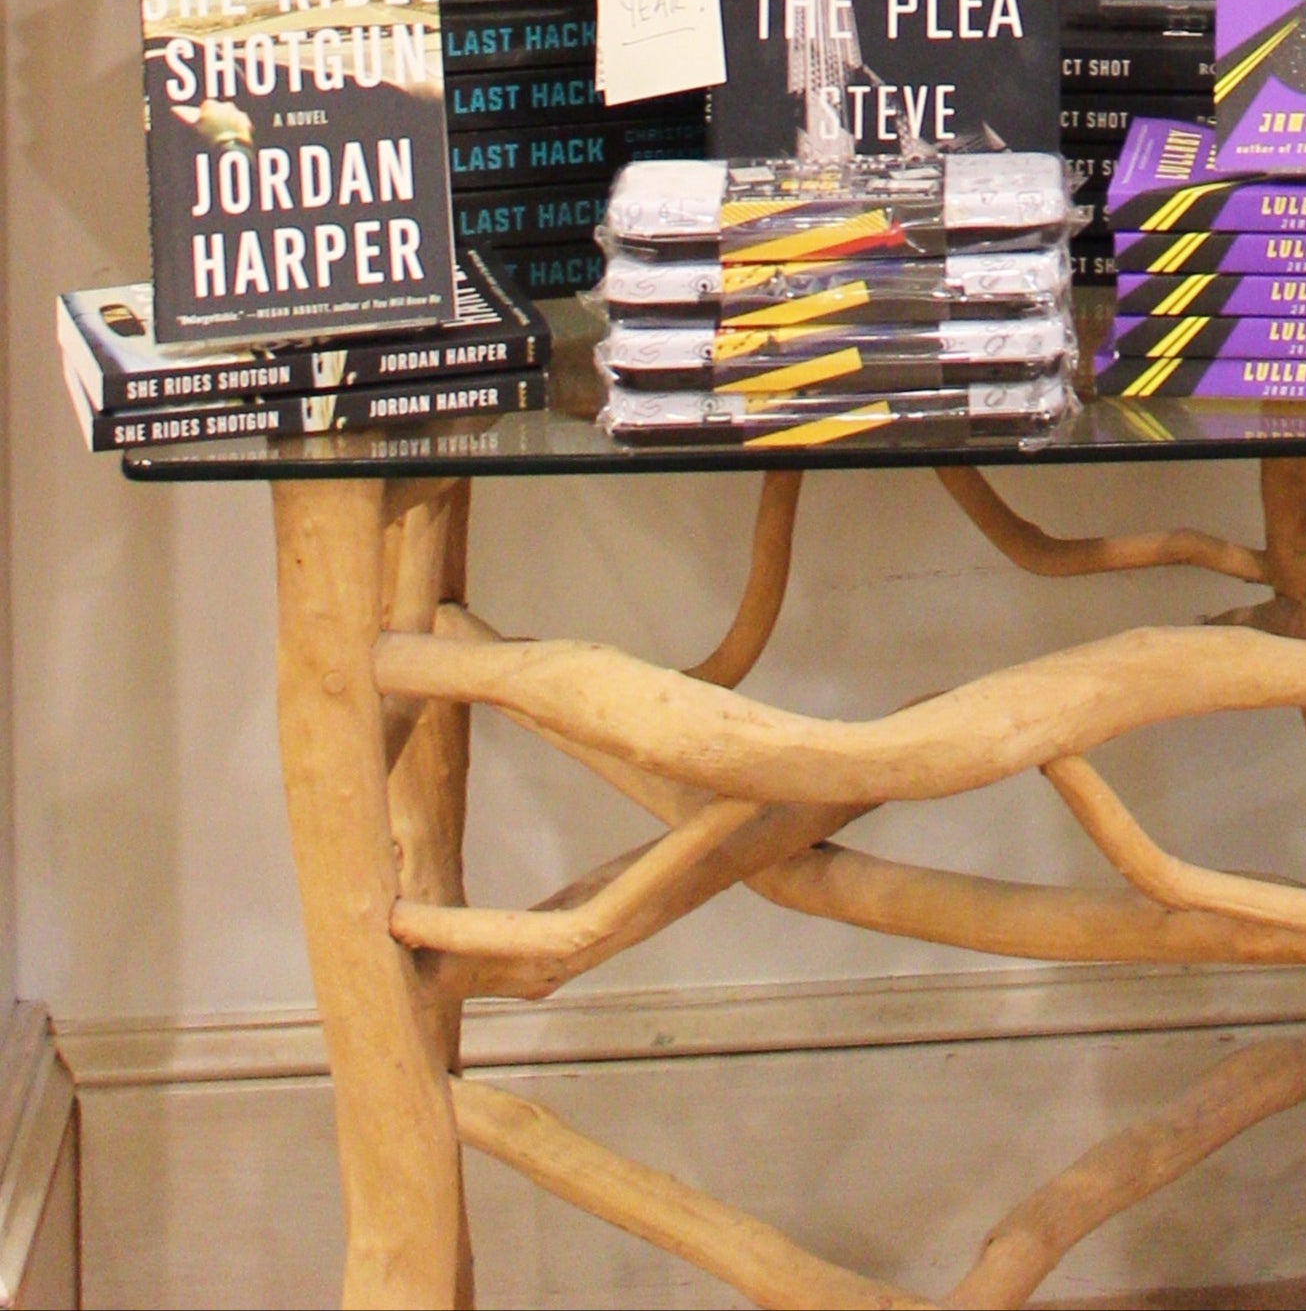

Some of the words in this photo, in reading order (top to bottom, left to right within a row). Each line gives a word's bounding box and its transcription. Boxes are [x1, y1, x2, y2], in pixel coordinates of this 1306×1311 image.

[446, 27, 513, 58] LAST
[164, 22, 428, 103] SHOTGUN
[1088, 59, 1132, 77] SHOT
[453, 84, 521, 115] LAST
[821, 84, 957, 141] STEVE
[273, 114, 283, 128] A
[286, 109, 329, 127] NOVEL
[1086, 111, 1129, 129] SHOT
[452, 143, 520, 173] LAST
[530, 137, 605, 167] HACK
[1235, 144, 1274, 155] author
[1277, 143, 1292, 155] of
[191, 137, 416, 218] JORDAN
[459, 205, 526, 236] LAST
[191, 218, 426, 299] HARPER
[379, 348, 440, 374] JORDAN
[444, 342, 508, 368] HARPER
[126, 379, 159, 401] SHE
[165, 373, 212, 397] RIDES
[217, 365, 291, 393] SHOTGUN
[369, 393, 431, 418] JORDAN
[436, 387, 500, 412] HARPER
[114, 421, 147, 444] SHE
[151, 415, 201, 439] RIDES
[206, 407, 280, 435] SHOTGUN
